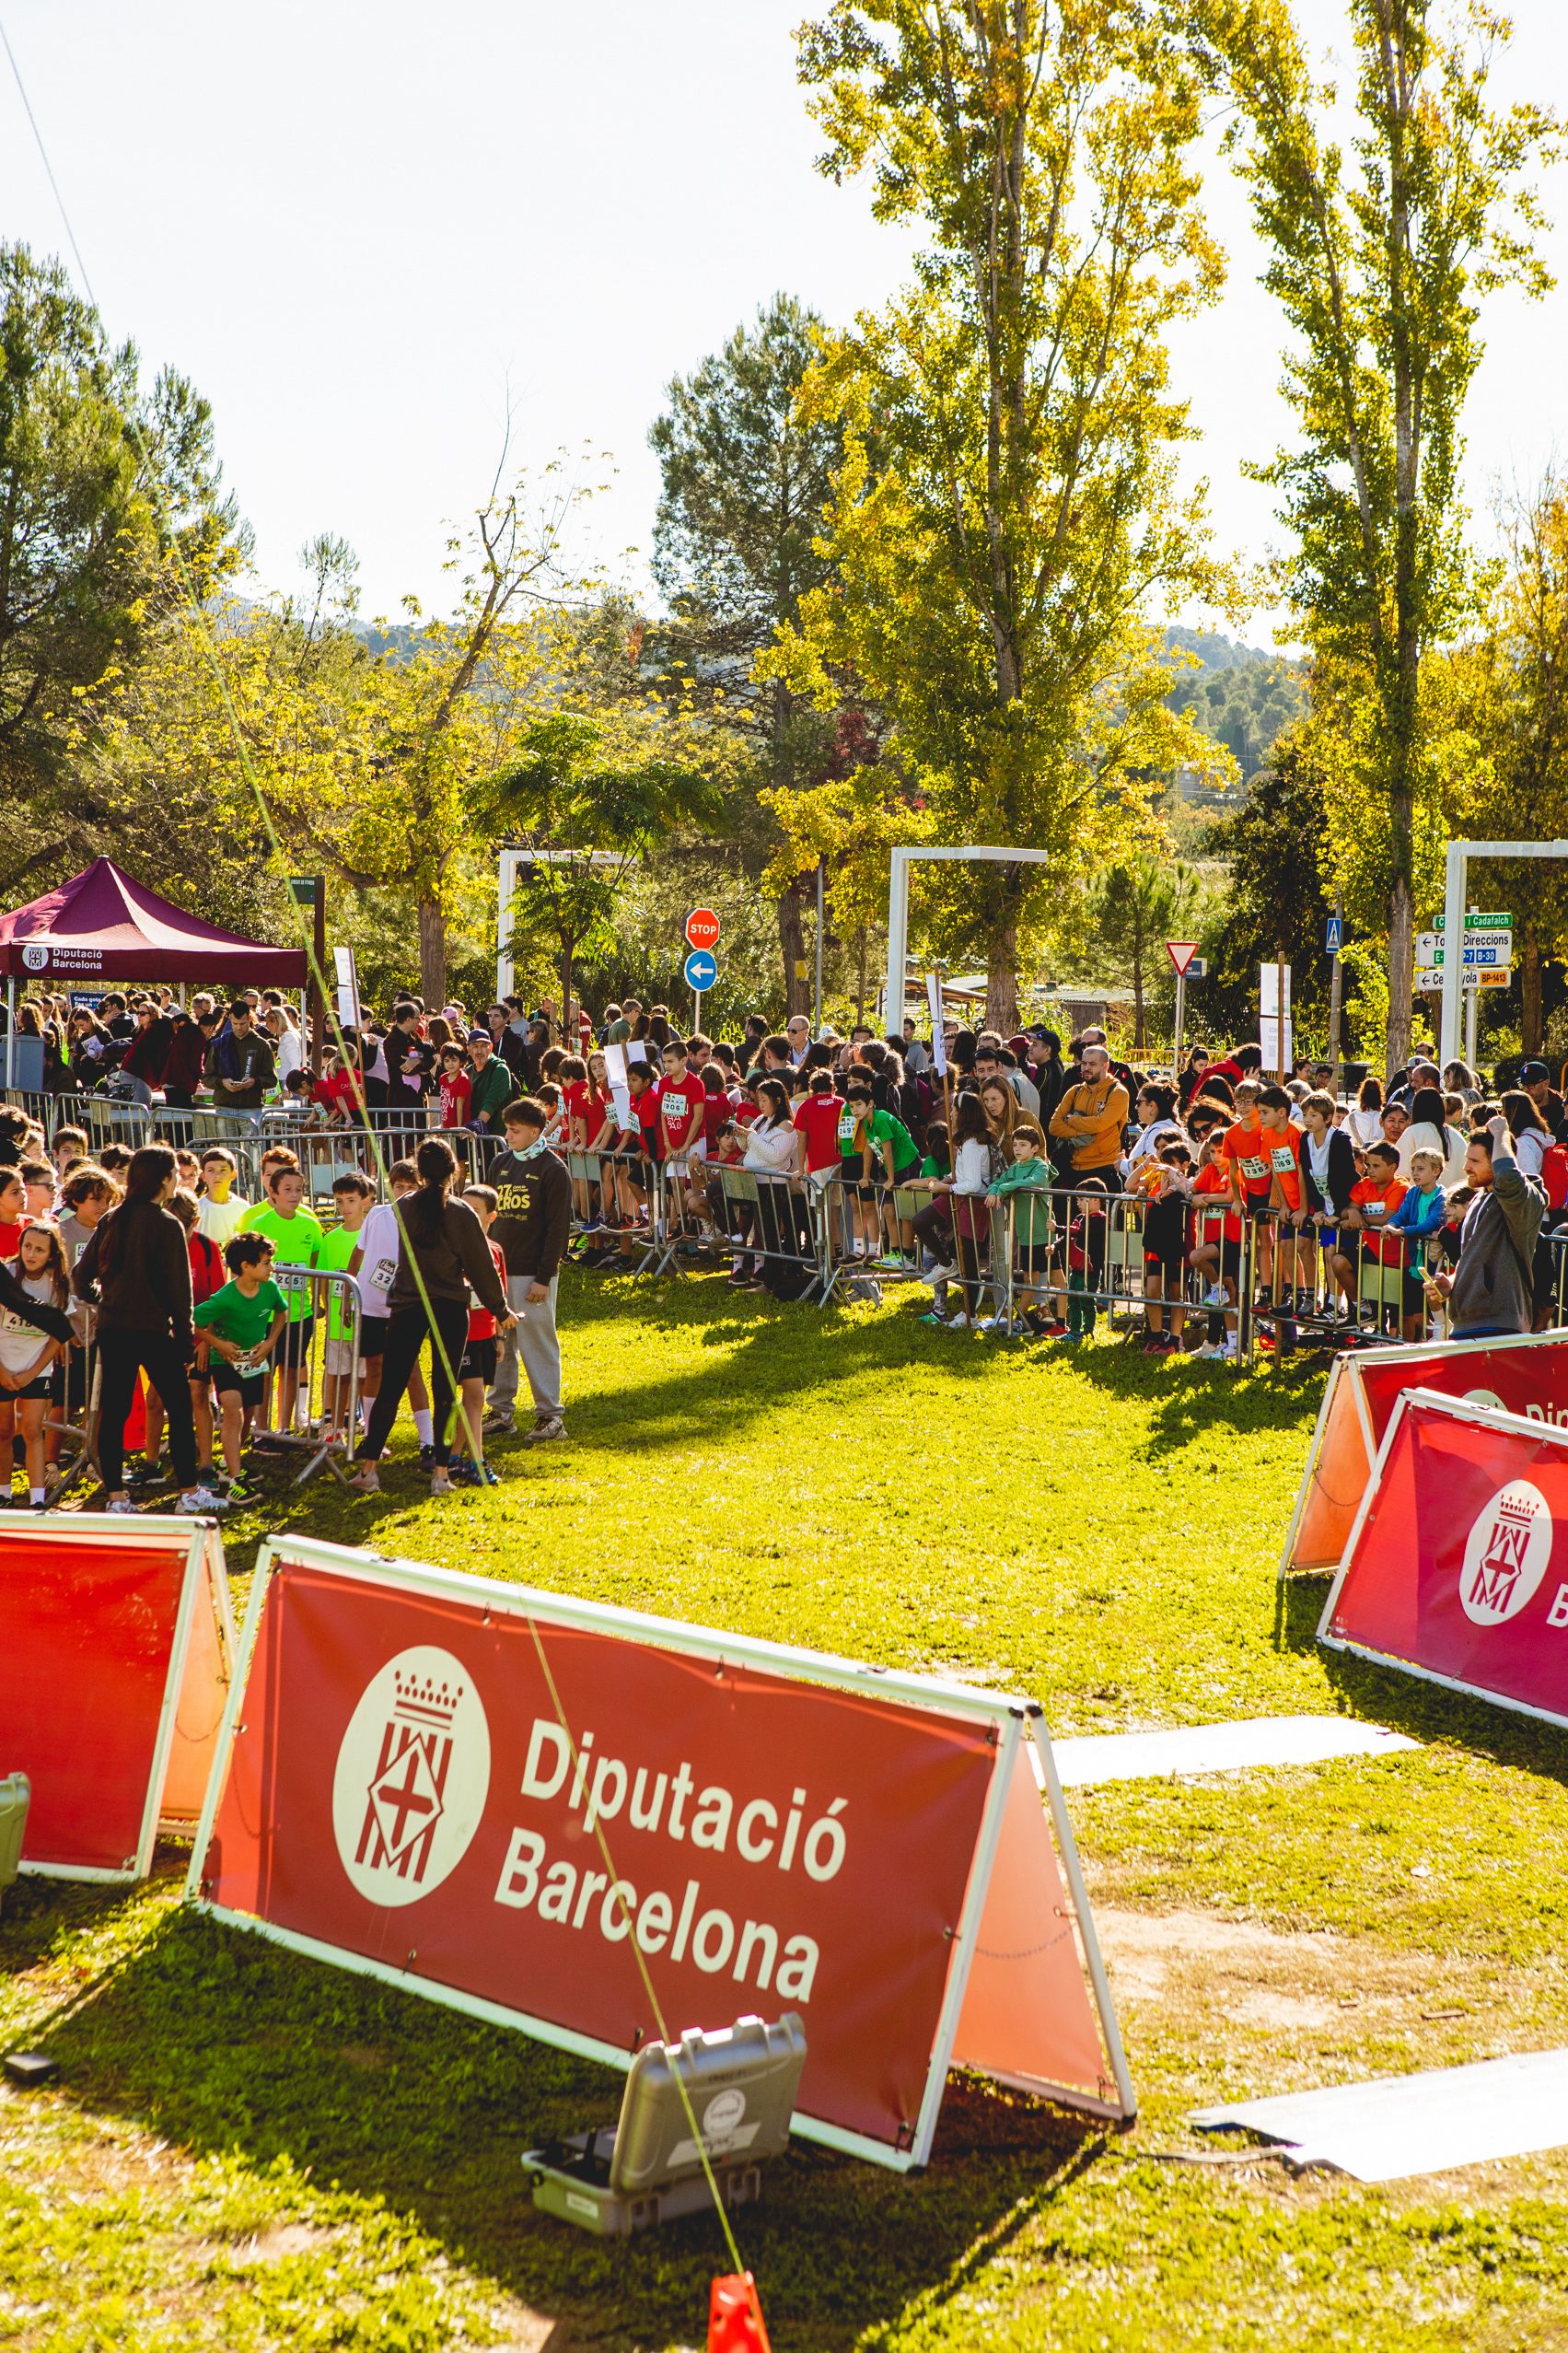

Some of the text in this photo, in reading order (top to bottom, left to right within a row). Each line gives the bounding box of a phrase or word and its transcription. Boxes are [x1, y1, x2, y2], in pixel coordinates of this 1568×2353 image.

[1473, 914, 1509, 926] Cadafalch
[691, 924, 716, 935] STOP
[1463, 934, 1509, 946] Direccions
[52, 948, 103, 959] Diputació
[1477, 951, 1495, 961] B-30
[52, 959, 102, 970] Barcelona
[1481, 973, 1506, 983] BP-1413
[520, 1718, 849, 1882] Diputació
[494, 1826, 820, 2004] Barcelona
